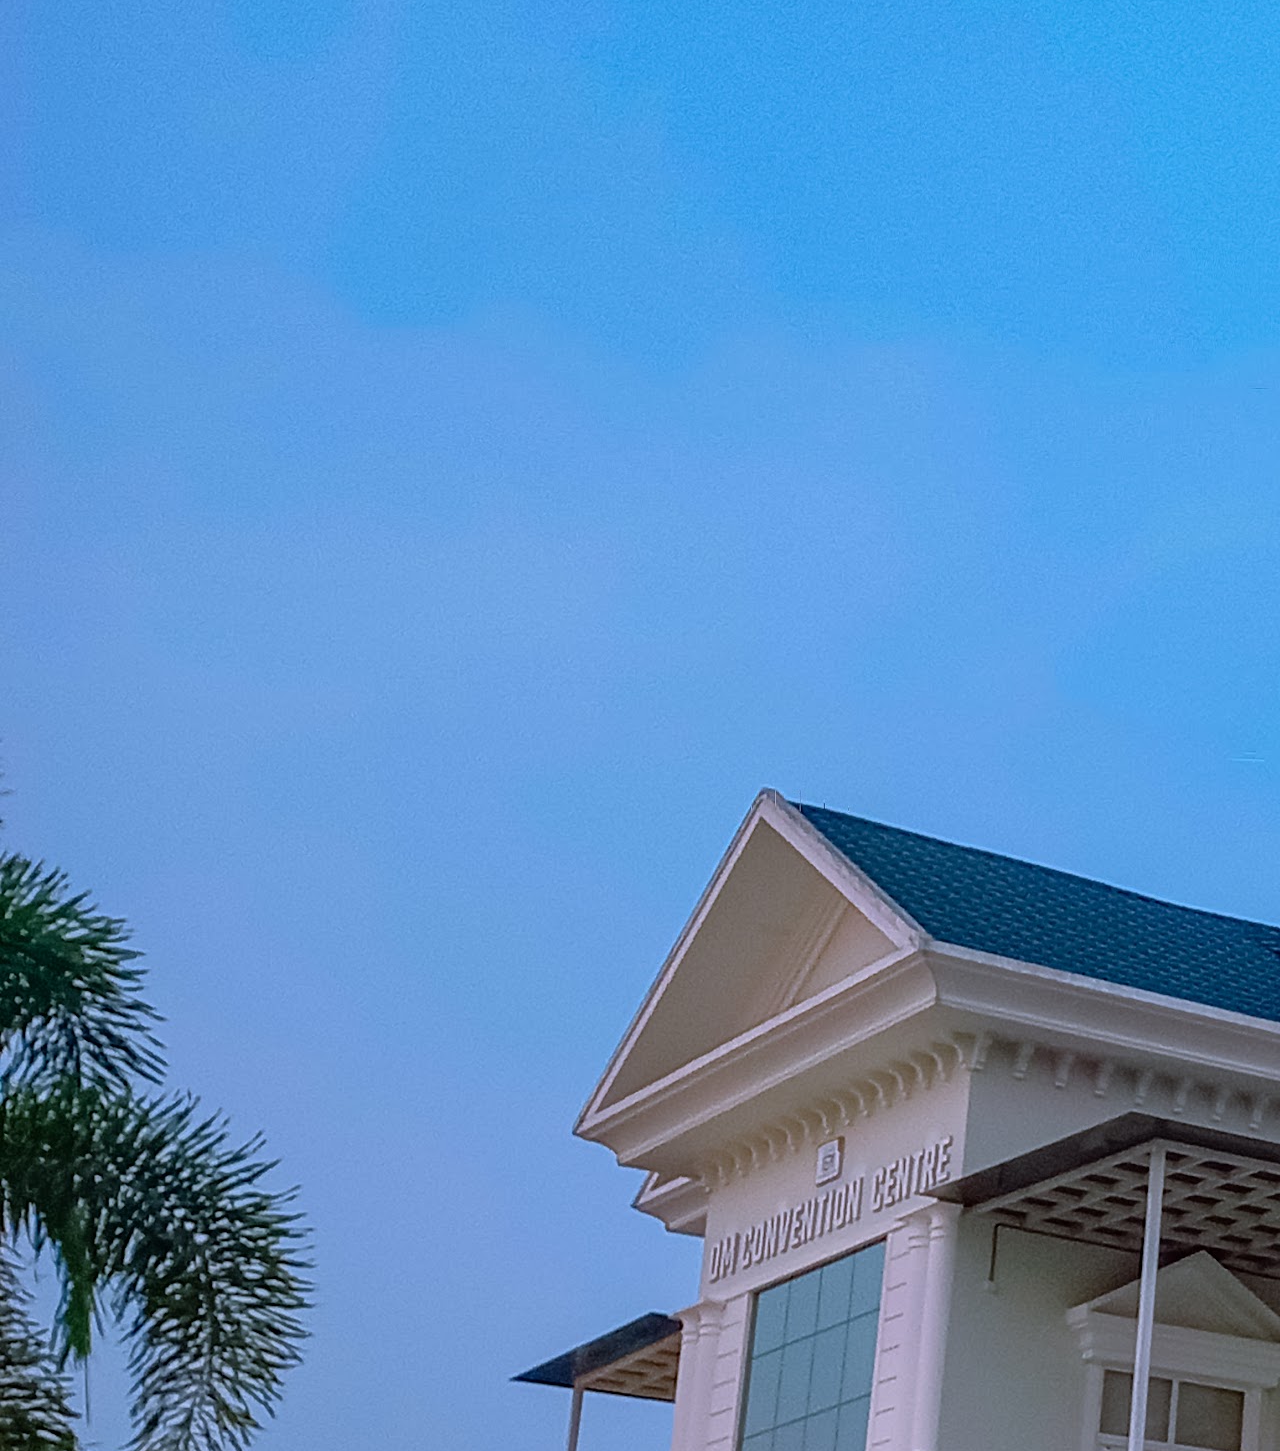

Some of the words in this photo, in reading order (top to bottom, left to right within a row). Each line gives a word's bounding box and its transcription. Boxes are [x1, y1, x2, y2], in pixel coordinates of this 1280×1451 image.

[710, 1232, 741, 1284] DM
[743, 1174, 865, 1269] CONVENTION
[872, 1134, 953, 1213] CENTRE
